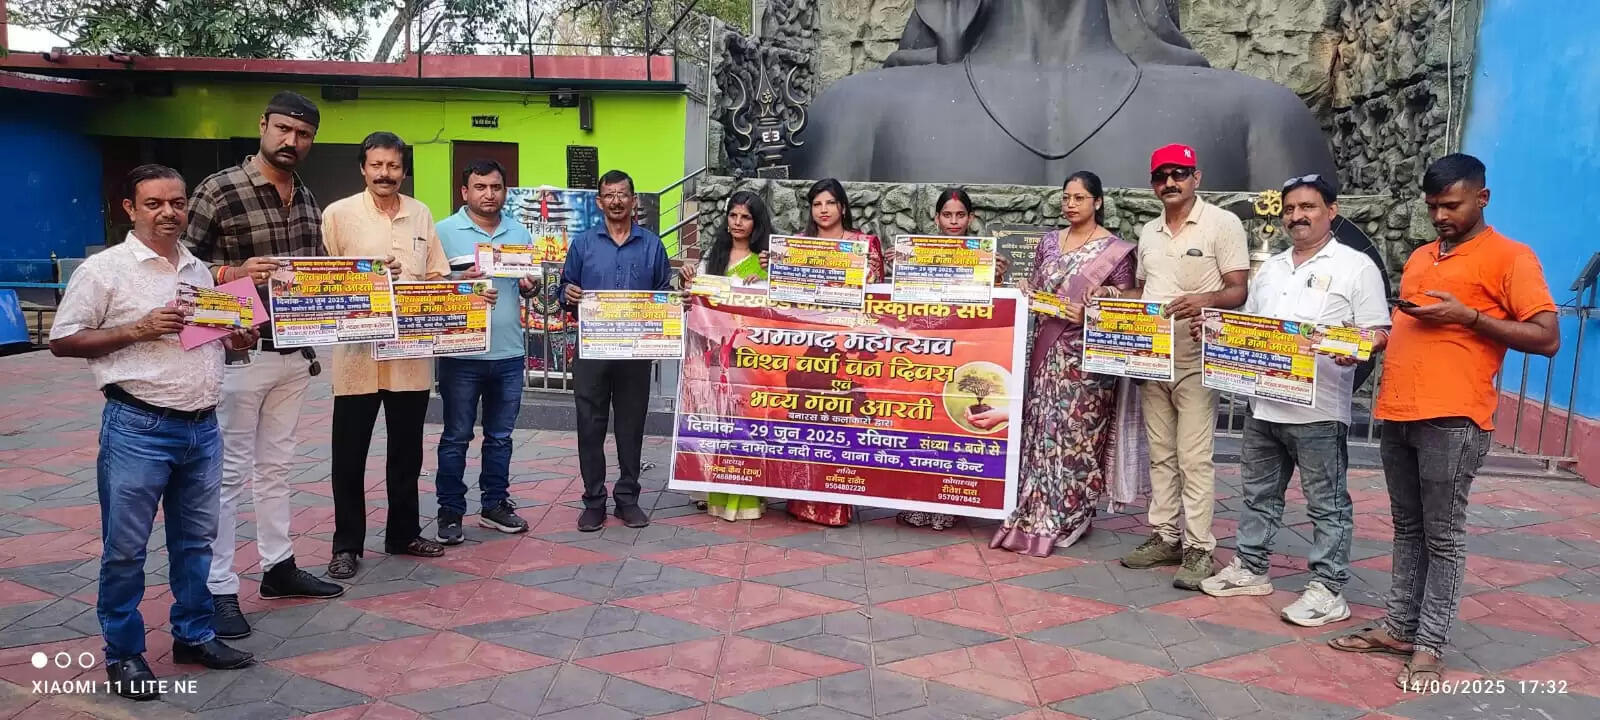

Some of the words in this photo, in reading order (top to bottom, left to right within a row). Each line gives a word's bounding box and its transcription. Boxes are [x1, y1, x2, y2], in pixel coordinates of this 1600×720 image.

[747, 327, 836, 352] रामगढ़
[844, 328, 956, 355] महोत्सव
[736, 346, 790, 371] विश्व
[796, 352, 841, 374] वर्षा
[845, 359, 884, 376] वन
[889, 356, 957, 382] दिवस
[831, 378, 853, 392] एवं
[750, 391, 799, 410] भव्य
[805, 391, 854, 414] गंगा
[859, 397, 934, 421] आरती
[788, 412, 818, 422] बनारस
[820, 411, 830, 422] के
[874, 417, 894, 427] द्वारा
[687, 415, 743, 435] दिनांक-
[750, 424, 768, 437] 29
[806, 428, 850, 447] 2025,
[857, 430, 908, 448] रविवार
[919, 436, 949, 451] संध्या
[954, 442, 961, 452] 5
[964, 440, 986, 455] बजे
[988, 441, 1001, 456] से
[698, 439, 737, 450] स्थान-
[742, 440, 784, 455] दामोदर
[788, 442, 810, 457] नदी
[814, 446, 836, 461] तट,
[841, 449, 870, 462] थाना
[874, 449, 904, 467] चौक,
[909, 455, 953, 472] रामगढ़
[956, 457, 985, 473] कैन्ट
[937, 493, 981, 504] 9570978452
[963, 488, 978, 496] दास
